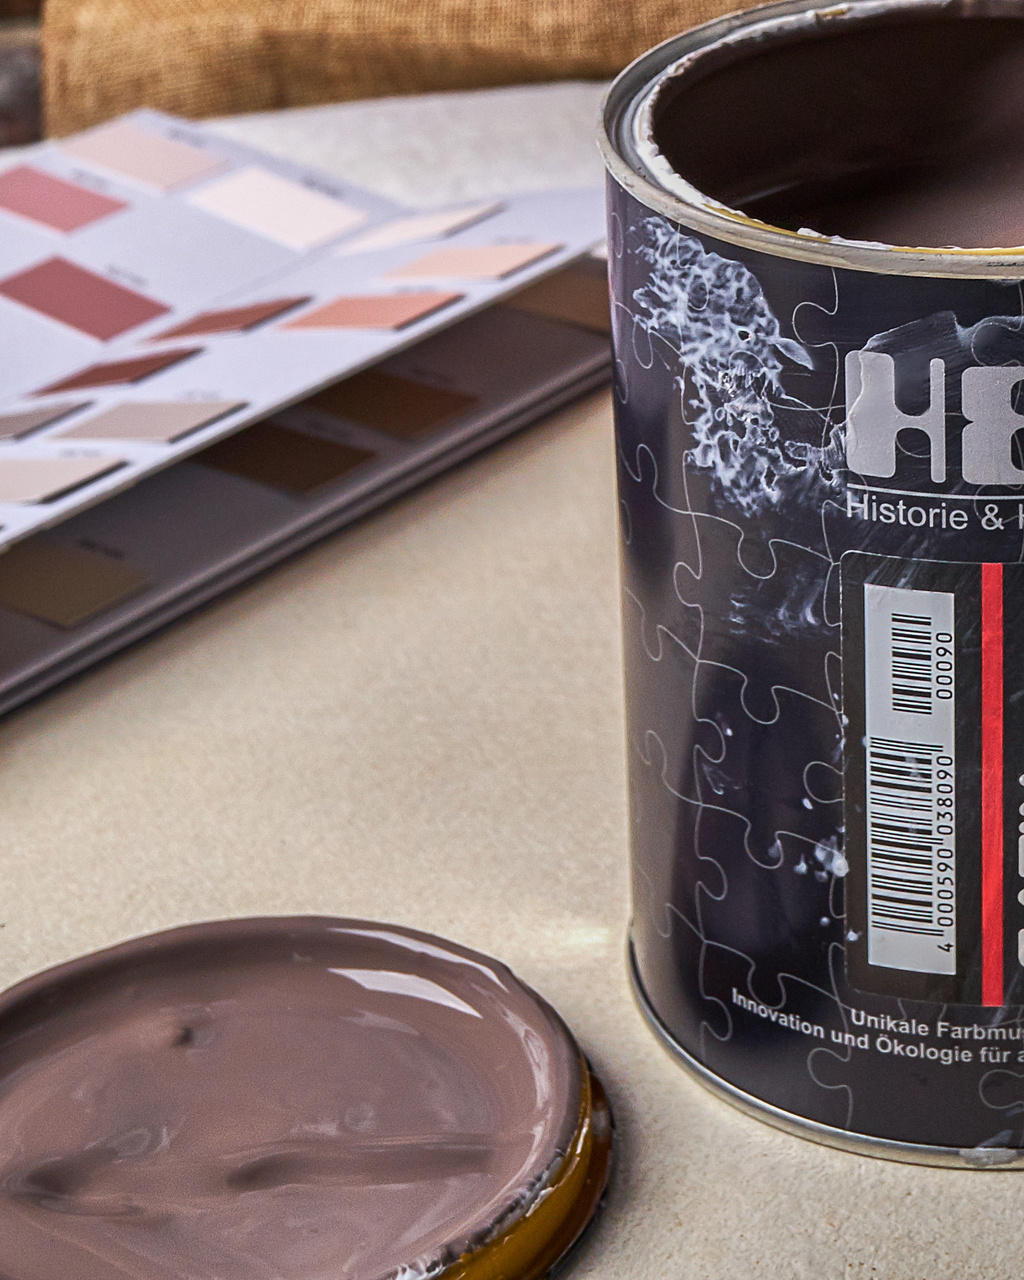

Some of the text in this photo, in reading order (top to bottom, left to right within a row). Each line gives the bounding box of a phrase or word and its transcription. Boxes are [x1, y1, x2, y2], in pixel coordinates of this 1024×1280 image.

[846, 490, 969, 529] Historie
[981, 503, 1005, 531] &
[936, 632, 953, 700] 00090
[936, 755, 954, 953] 4 000590 038090
[732, 987, 825, 1039] Innovation
[831, 1031, 870, 1050] und
[876, 1034, 973, 1065] Ökologie
[979, 1046, 1012, 1063] für
[851, 1007, 929, 1036] Unikale
